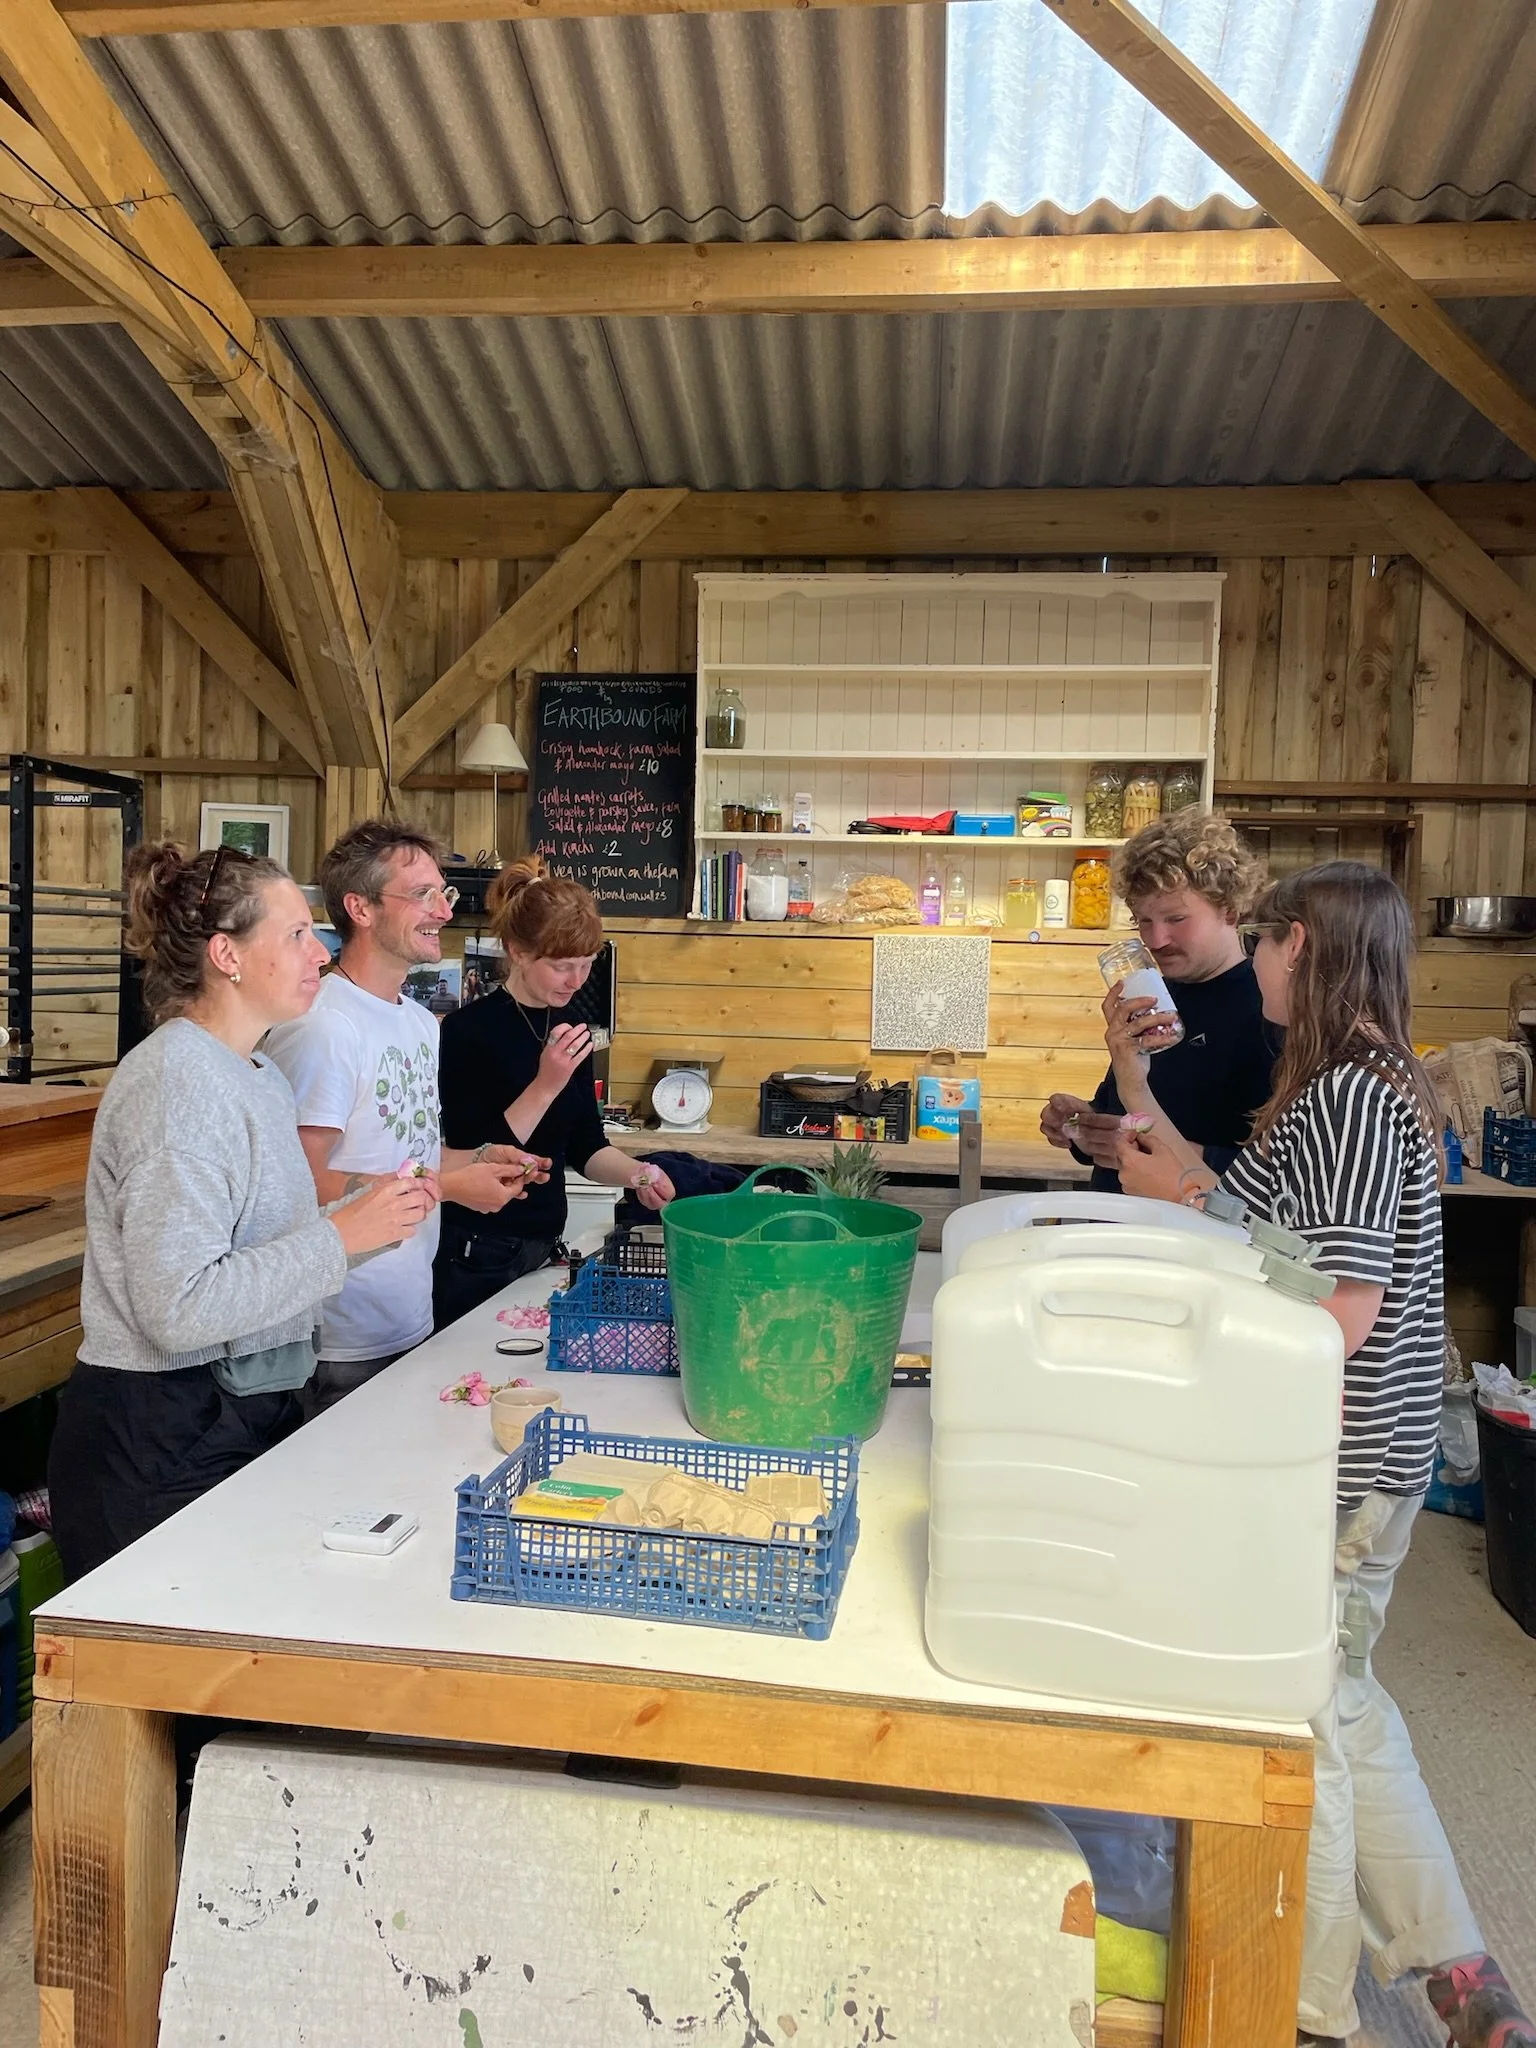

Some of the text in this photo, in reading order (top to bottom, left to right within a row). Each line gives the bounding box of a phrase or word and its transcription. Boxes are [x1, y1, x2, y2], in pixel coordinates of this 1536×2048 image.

[621, 686, 663, 694] SOUNDS
[541, 739, 574, 758] Crispy
[638, 759, 660, 775] £10
[60, 795, 89, 803] MIRAFIT
[538, 786, 570, 810] Grilled
[656, 818, 673, 839] £8
[535, 838, 557, 860] Add
[602, 840, 622, 857] £2
[553, 863, 575, 883] veg
[577, 864, 587, 877] is
[592, 864, 627, 887] grown
[628, 866, 643, 881] on
[550, 1483, 572, 1491] Colin
